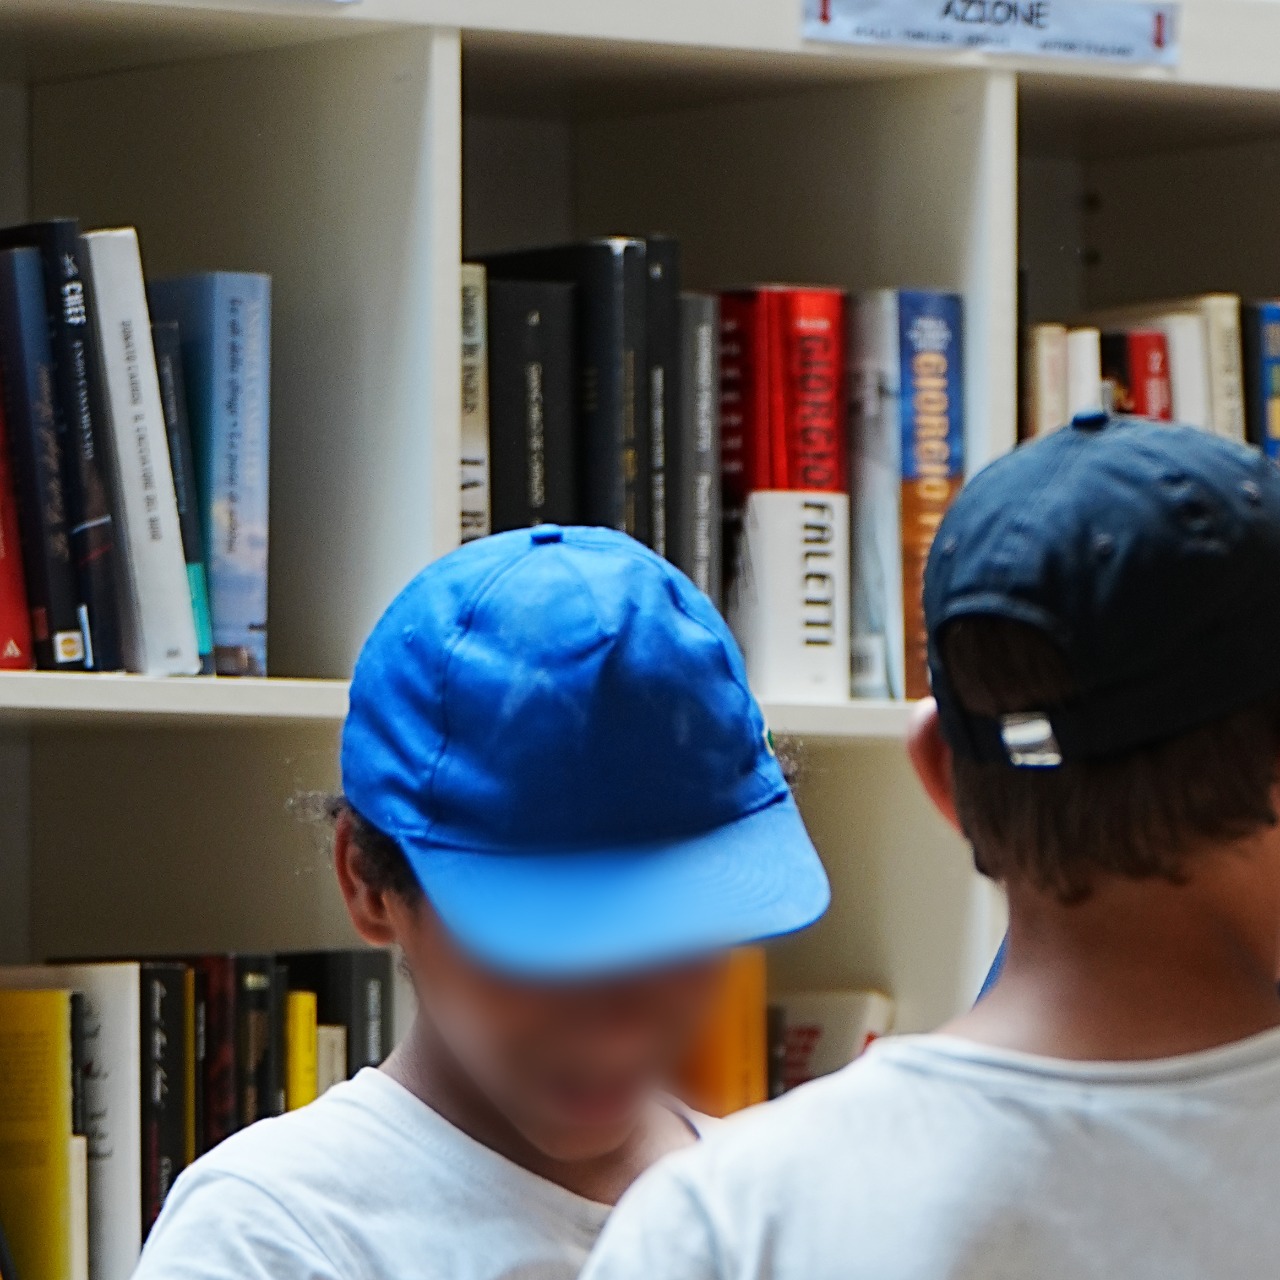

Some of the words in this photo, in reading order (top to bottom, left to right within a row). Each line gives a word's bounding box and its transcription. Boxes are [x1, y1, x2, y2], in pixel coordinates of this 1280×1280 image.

[62, 279, 87, 326] CHEF
[801, 335, 833, 487] GIORGIO
[912, 352, 952, 500] GIORGIO
[803, 500, 834, 648] FALETTI
